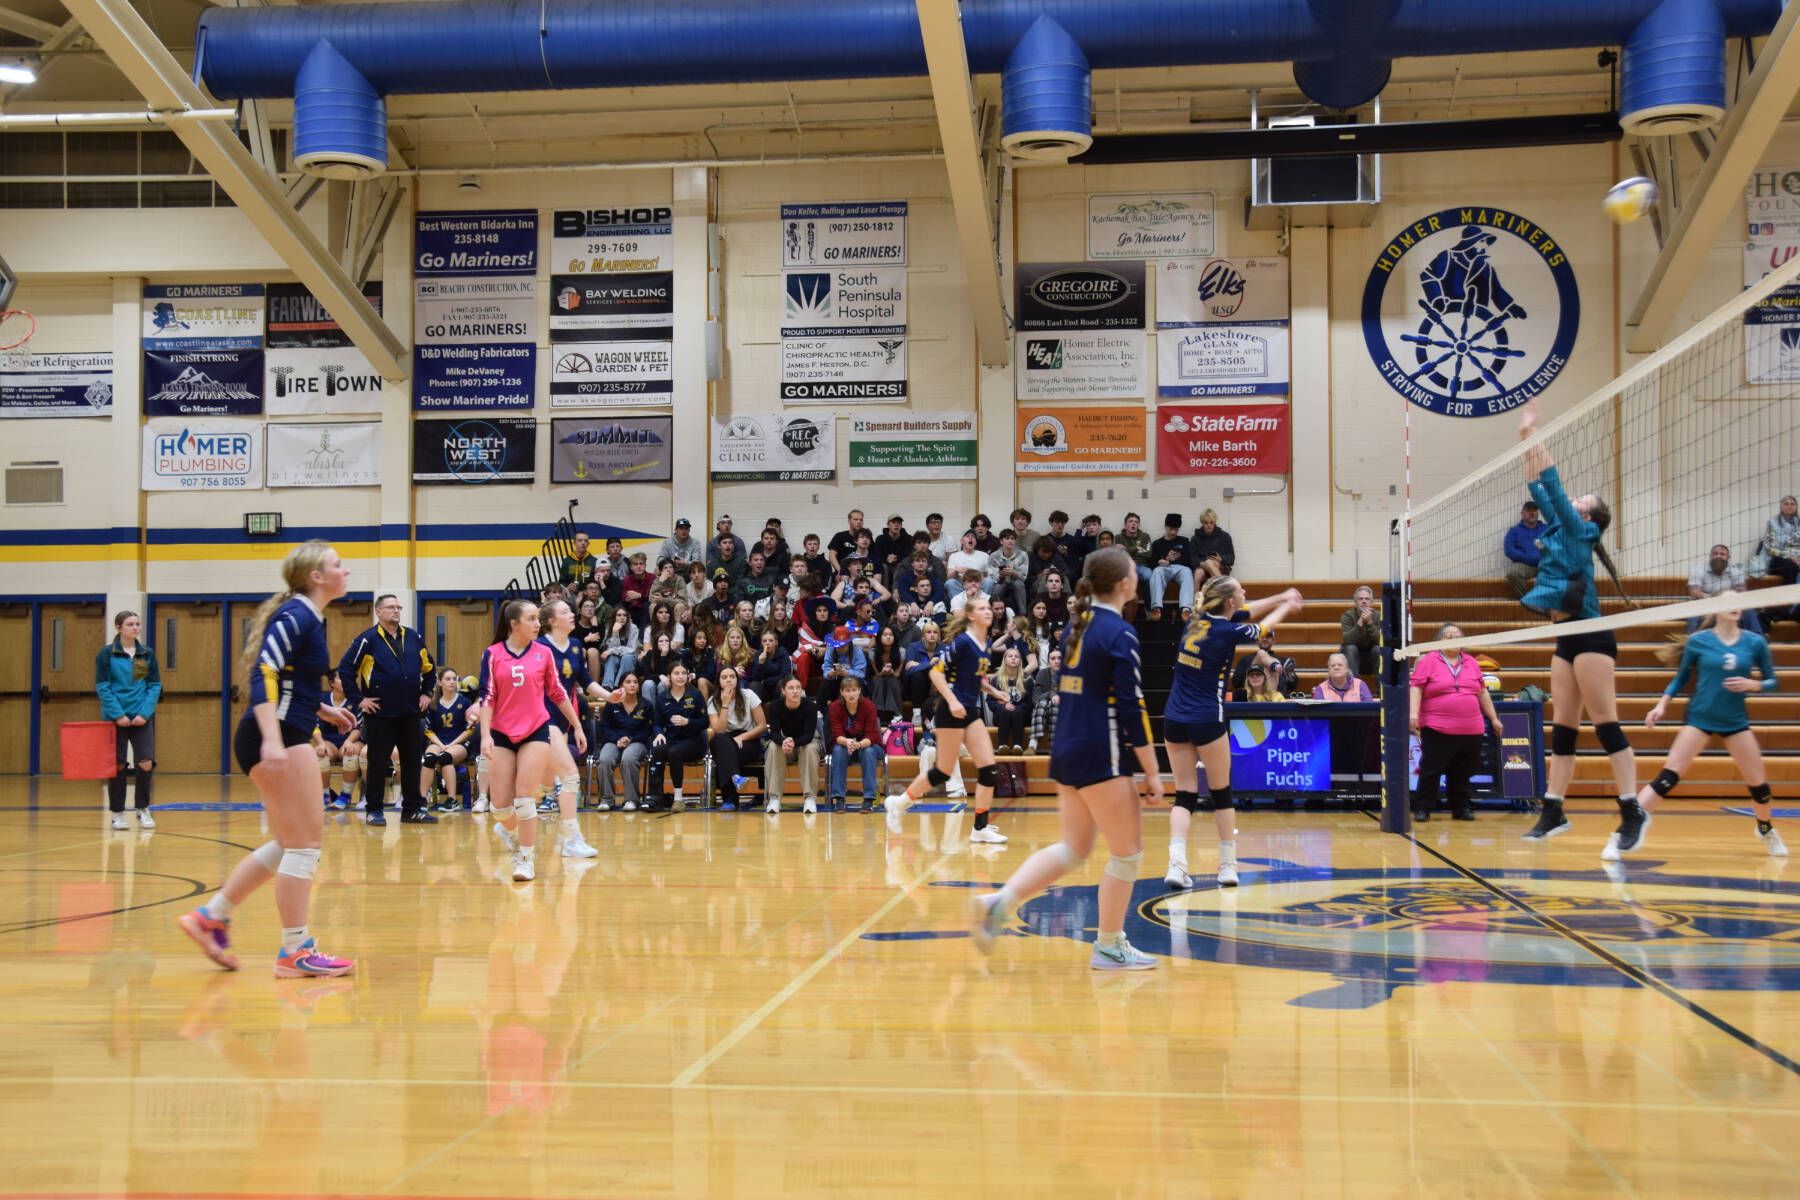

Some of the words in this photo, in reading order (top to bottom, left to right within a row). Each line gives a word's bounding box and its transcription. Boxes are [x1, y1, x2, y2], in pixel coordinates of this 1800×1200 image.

[879, 205, 906, 214] Therapy
[420, 222, 439, 231] Best
[441, 221, 478, 230] Western
[481, 219, 516, 229] Bidarka
[519, 219, 534, 228] Inn
[554, 208, 671, 237] BISHOP
[829, 223, 851, 233] (907)
[853, 222, 894, 232] 250-1812
[454, 234, 498, 244] 235-8148
[1117, 233, 1132, 247] Go
[1134, 232, 1186, 244] Mariners!
[1377, 215, 1442, 272] HOMER
[1460, 208, 1565, 267] MARINERS
[588, 243, 638, 253] 299-7609
[824, 248, 839, 259] GO
[842, 246, 901, 258] MARINERS!
[420, 253, 444, 268] Go
[450, 250, 533, 267] Mariners!
[569, 259, 586, 272] Go
[838, 272, 878, 286] South
[1198, 266, 1246, 301] Elks
[167, 287, 181, 297] GO
[184, 286, 243, 296] MARINERS!
[1039, 280, 1119, 293] GREGOIRE
[586, 290, 607, 298] BAY
[611, 289, 666, 298] WELDING
[838, 288, 902, 302] Peninsula
[175, 307, 256, 321] COASTLINE
[838, 304, 895, 322] Hospital
[1761, 314, 1794, 322] HOMER
[425, 325, 446, 337] GO
[449, 323, 527, 336] MARINERS!
[1184, 330, 1259, 345] Lakeshore
[1064, 340, 1095, 348] Homer
[1097, 339, 1131, 347] Electric
[1203, 341, 1239, 349] GLASS
[170, 354, 199, 363] FINISH
[202, 354, 239, 362] STRONG
[421, 348, 441, 358] D&D
[442, 348, 479, 360] Welding
[480, 347, 530, 358] Fabricators
[595, 353, 631, 363] WAGON
[634, 352, 668, 362] WHEEL
[1064, 353, 1118, 361] Association,
[1120, 351, 1138, 360] Inc.
[44, 356, 113, 369] Refrigeration
[1197, 357, 1246, 366] 235-8505
[467, 367, 505, 376] DeVaney
[595, 365, 637, 373] GARDEN
[650, 364, 668, 372] PET
[270, 366, 319, 397] TIRE
[320, 364, 382, 396] TOWN
[429, 379, 458, 387] Phone:
[460, 378, 481, 387] (907)
[482, 378, 522, 386] 299-1236
[1380, 359, 1434, 407] STRIVING
[1446, 402, 1473, 416] FOR
[1487, 354, 1565, 413] EXCELLENCE
[578, 384, 601, 393] (907)
[603, 383, 646, 393] 235-8777
[785, 386, 809, 396] GO
[812, 384, 902, 396] MARINERS!
[1191, 387, 1205, 395] GO
[1207, 386, 1256, 394] MARINERS!
[420, 396, 451, 405] Show
[453, 395, 496, 405] Mariner
[498, 395, 529, 404] Pride!
[866, 422, 901, 431] Spenard
[904, 422, 940, 430] Builders
[942, 421, 972, 430] Supply
[577, 425, 652, 444] SUMMIT
[443, 438, 507, 448] NORTH
[870, 445, 914, 453] Supporting
[933, 444, 956, 453] Spirit
[1189, 441, 1219, 451] Mike
[1222, 440, 1257, 451] Barth
[450, 449, 501, 460] WEST
[719, 453, 766, 462] CLINIC
[902, 455, 934, 463] Alaska's
[159, 458, 246, 472] PLUMBING
[1024, 463, 1068, 471] Professional
[1190, 458, 1257, 467] 907-226-3600
[780, 472, 790, 480] GO
[792, 471, 830, 480] MARINERS!
[180, 478, 198, 487] 907
[201, 478, 219, 487] 756
[223, 477, 246, 487] 8055
[1184, 620, 1211, 654] 2
[1722, 653, 1737, 671] 3
[562, 659, 573, 679] 4
[512, 665, 526, 688] 5
[441, 712, 454, 728] 12
[1288, 727, 1298, 740] 0
[1267, 748, 1310, 767] Piper
[1265, 771, 1313, 786] Fuchs
